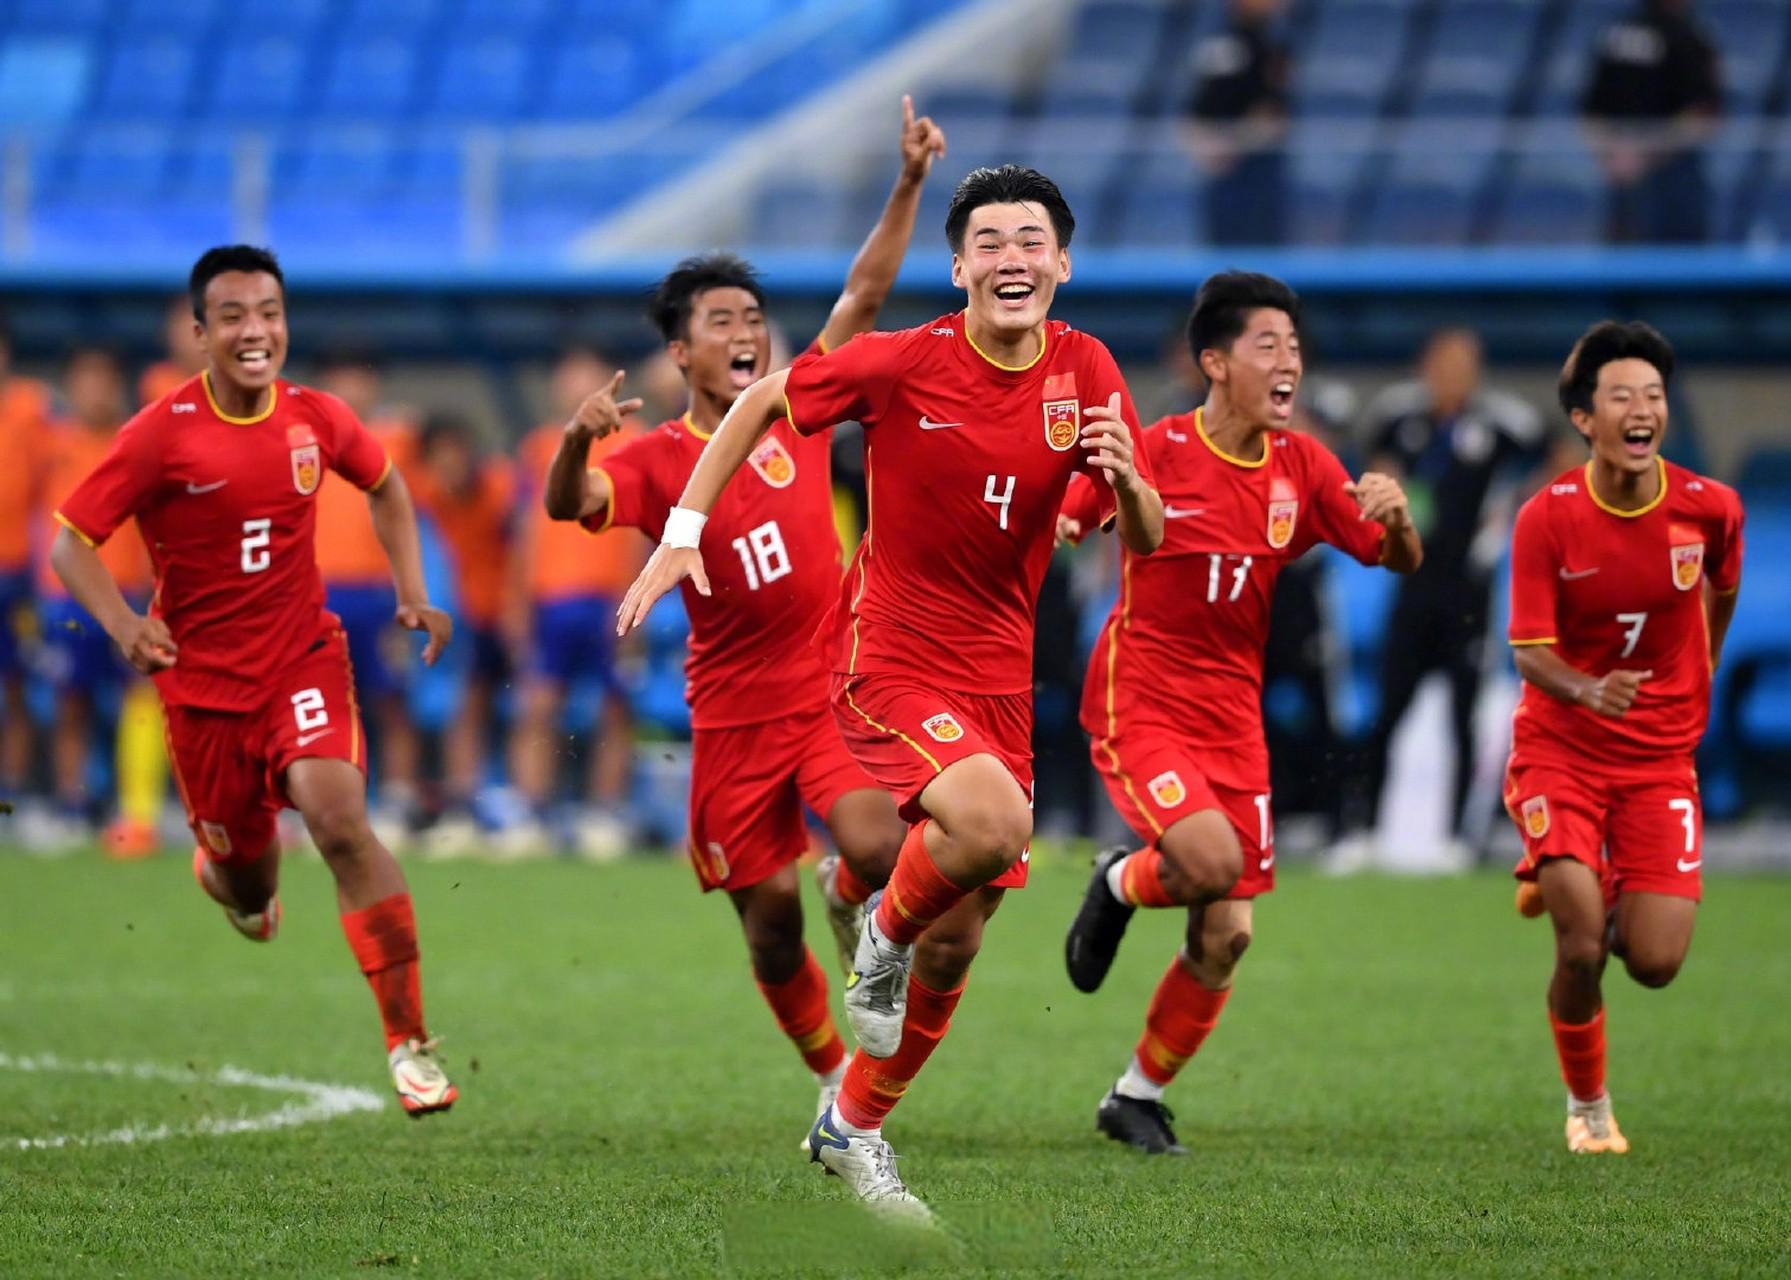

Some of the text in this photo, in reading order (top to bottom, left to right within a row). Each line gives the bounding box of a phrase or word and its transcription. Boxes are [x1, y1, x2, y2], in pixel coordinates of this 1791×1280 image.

[930, 327, 954, 337] CFA
[1048, 403, 1075, 416] CFA
[983, 474, 1017, 530] 4
[241, 518, 272, 573] 2
[731, 520, 793, 591] 18
[1207, 553, 1253, 603] 17
[1615, 612, 1648, 659] 7
[290, 687, 329, 732] 2
[1668, 798, 1695, 853] 7
